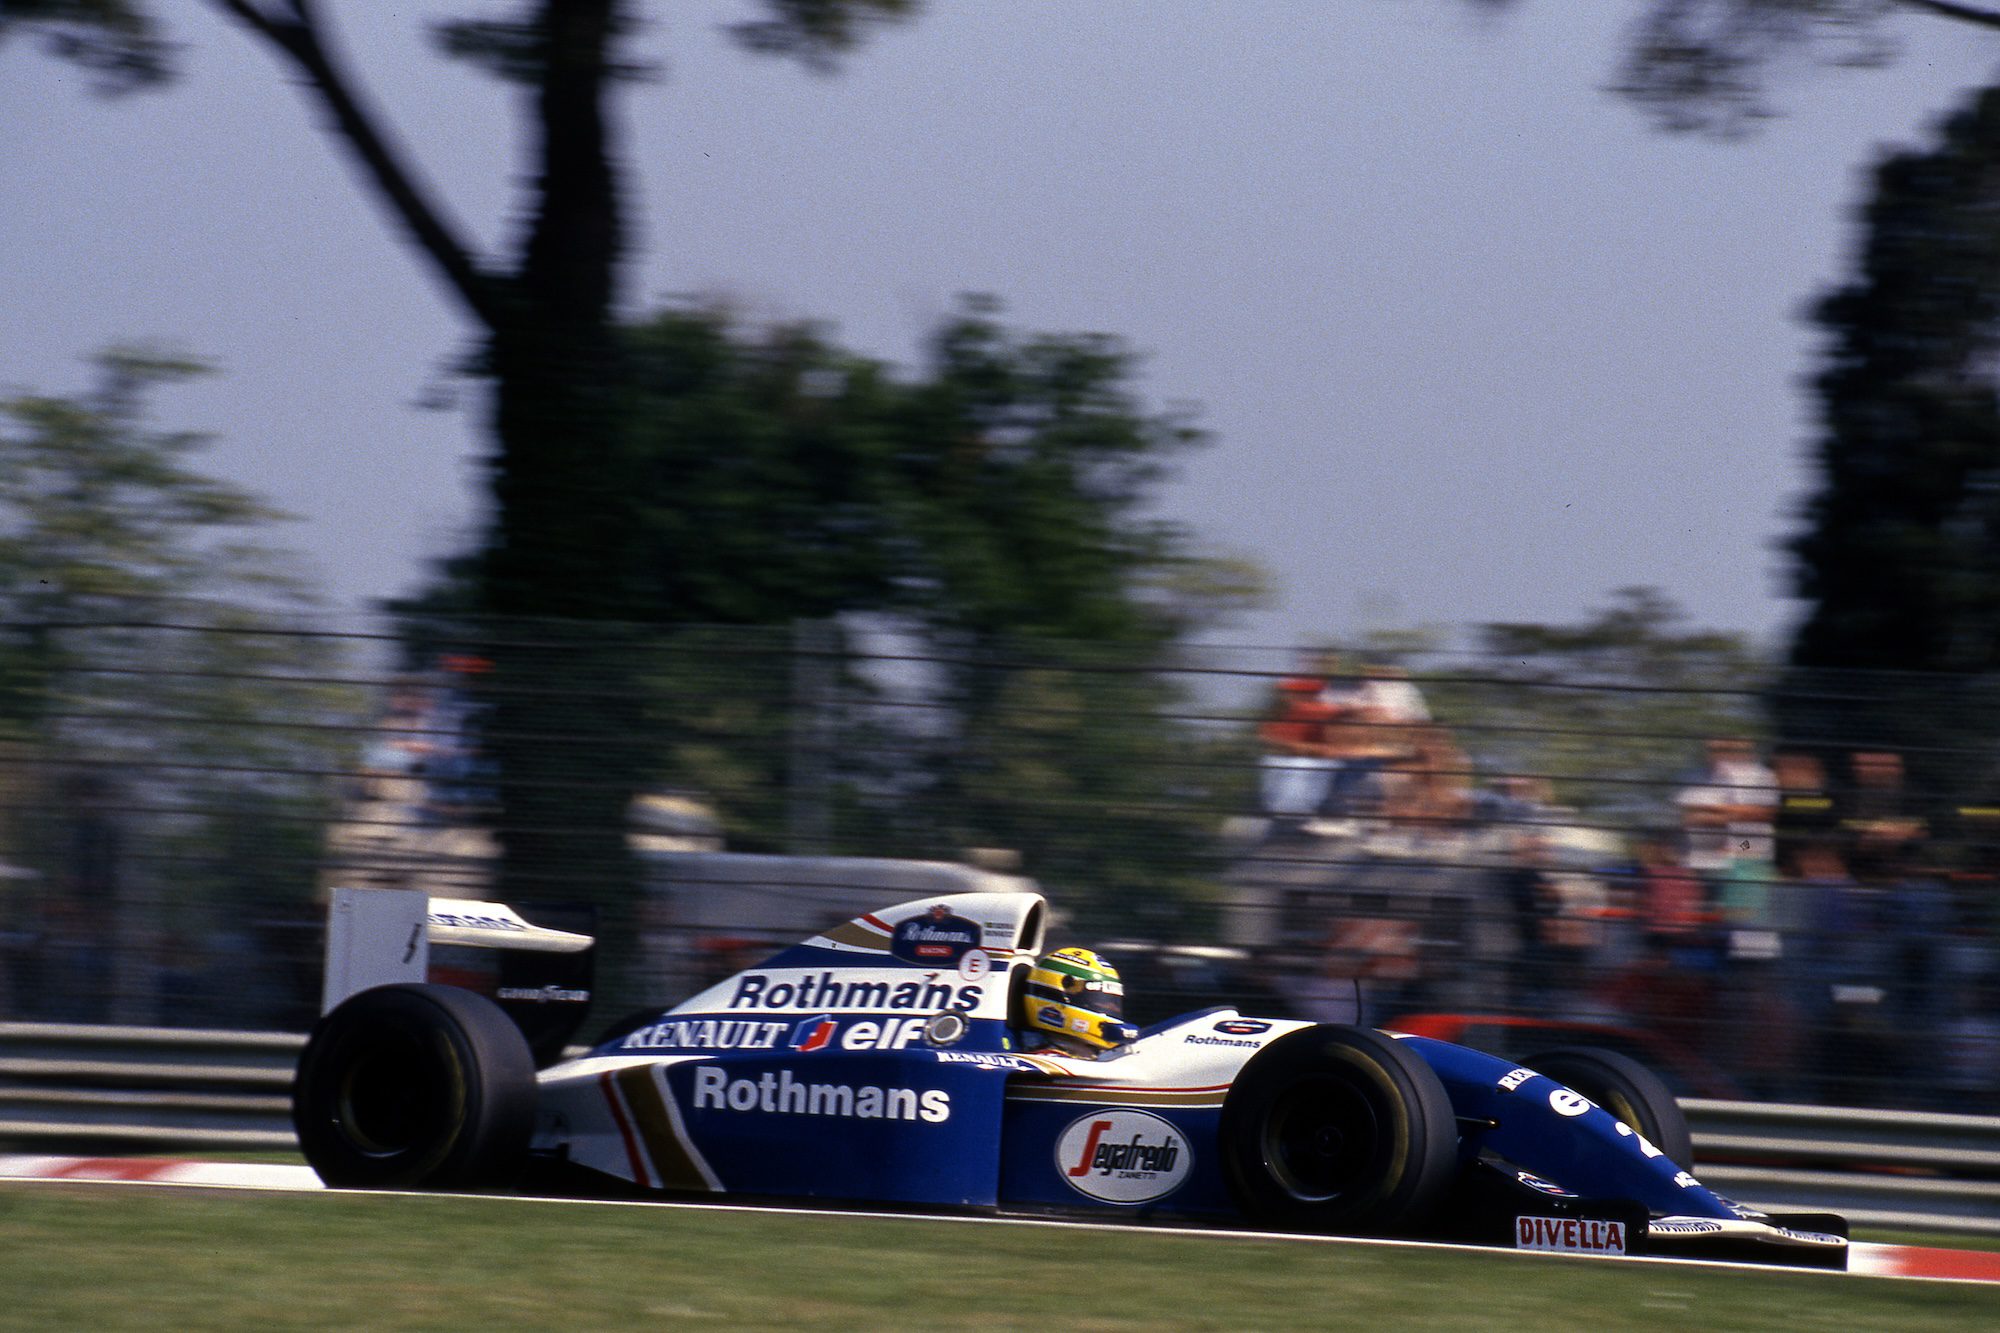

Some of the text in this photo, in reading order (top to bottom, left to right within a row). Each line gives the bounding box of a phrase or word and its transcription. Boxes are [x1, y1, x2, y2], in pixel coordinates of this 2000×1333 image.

[970, 959, 980, 973] E
[730, 972, 984, 1012] Rothmans
[620, 1020, 789, 1049] RENAULT
[841, 1018, 927, 1051] elf
[1184, 1034, 1262, 1049] Rothmans
[936, 1051, 1019, 1068] RENAULT
[693, 1065, 951, 1124] Rothmans
[1068, 1120, 1178, 1177] Segafredo
[1519, 1218, 1623, 1251] DIVELLA
